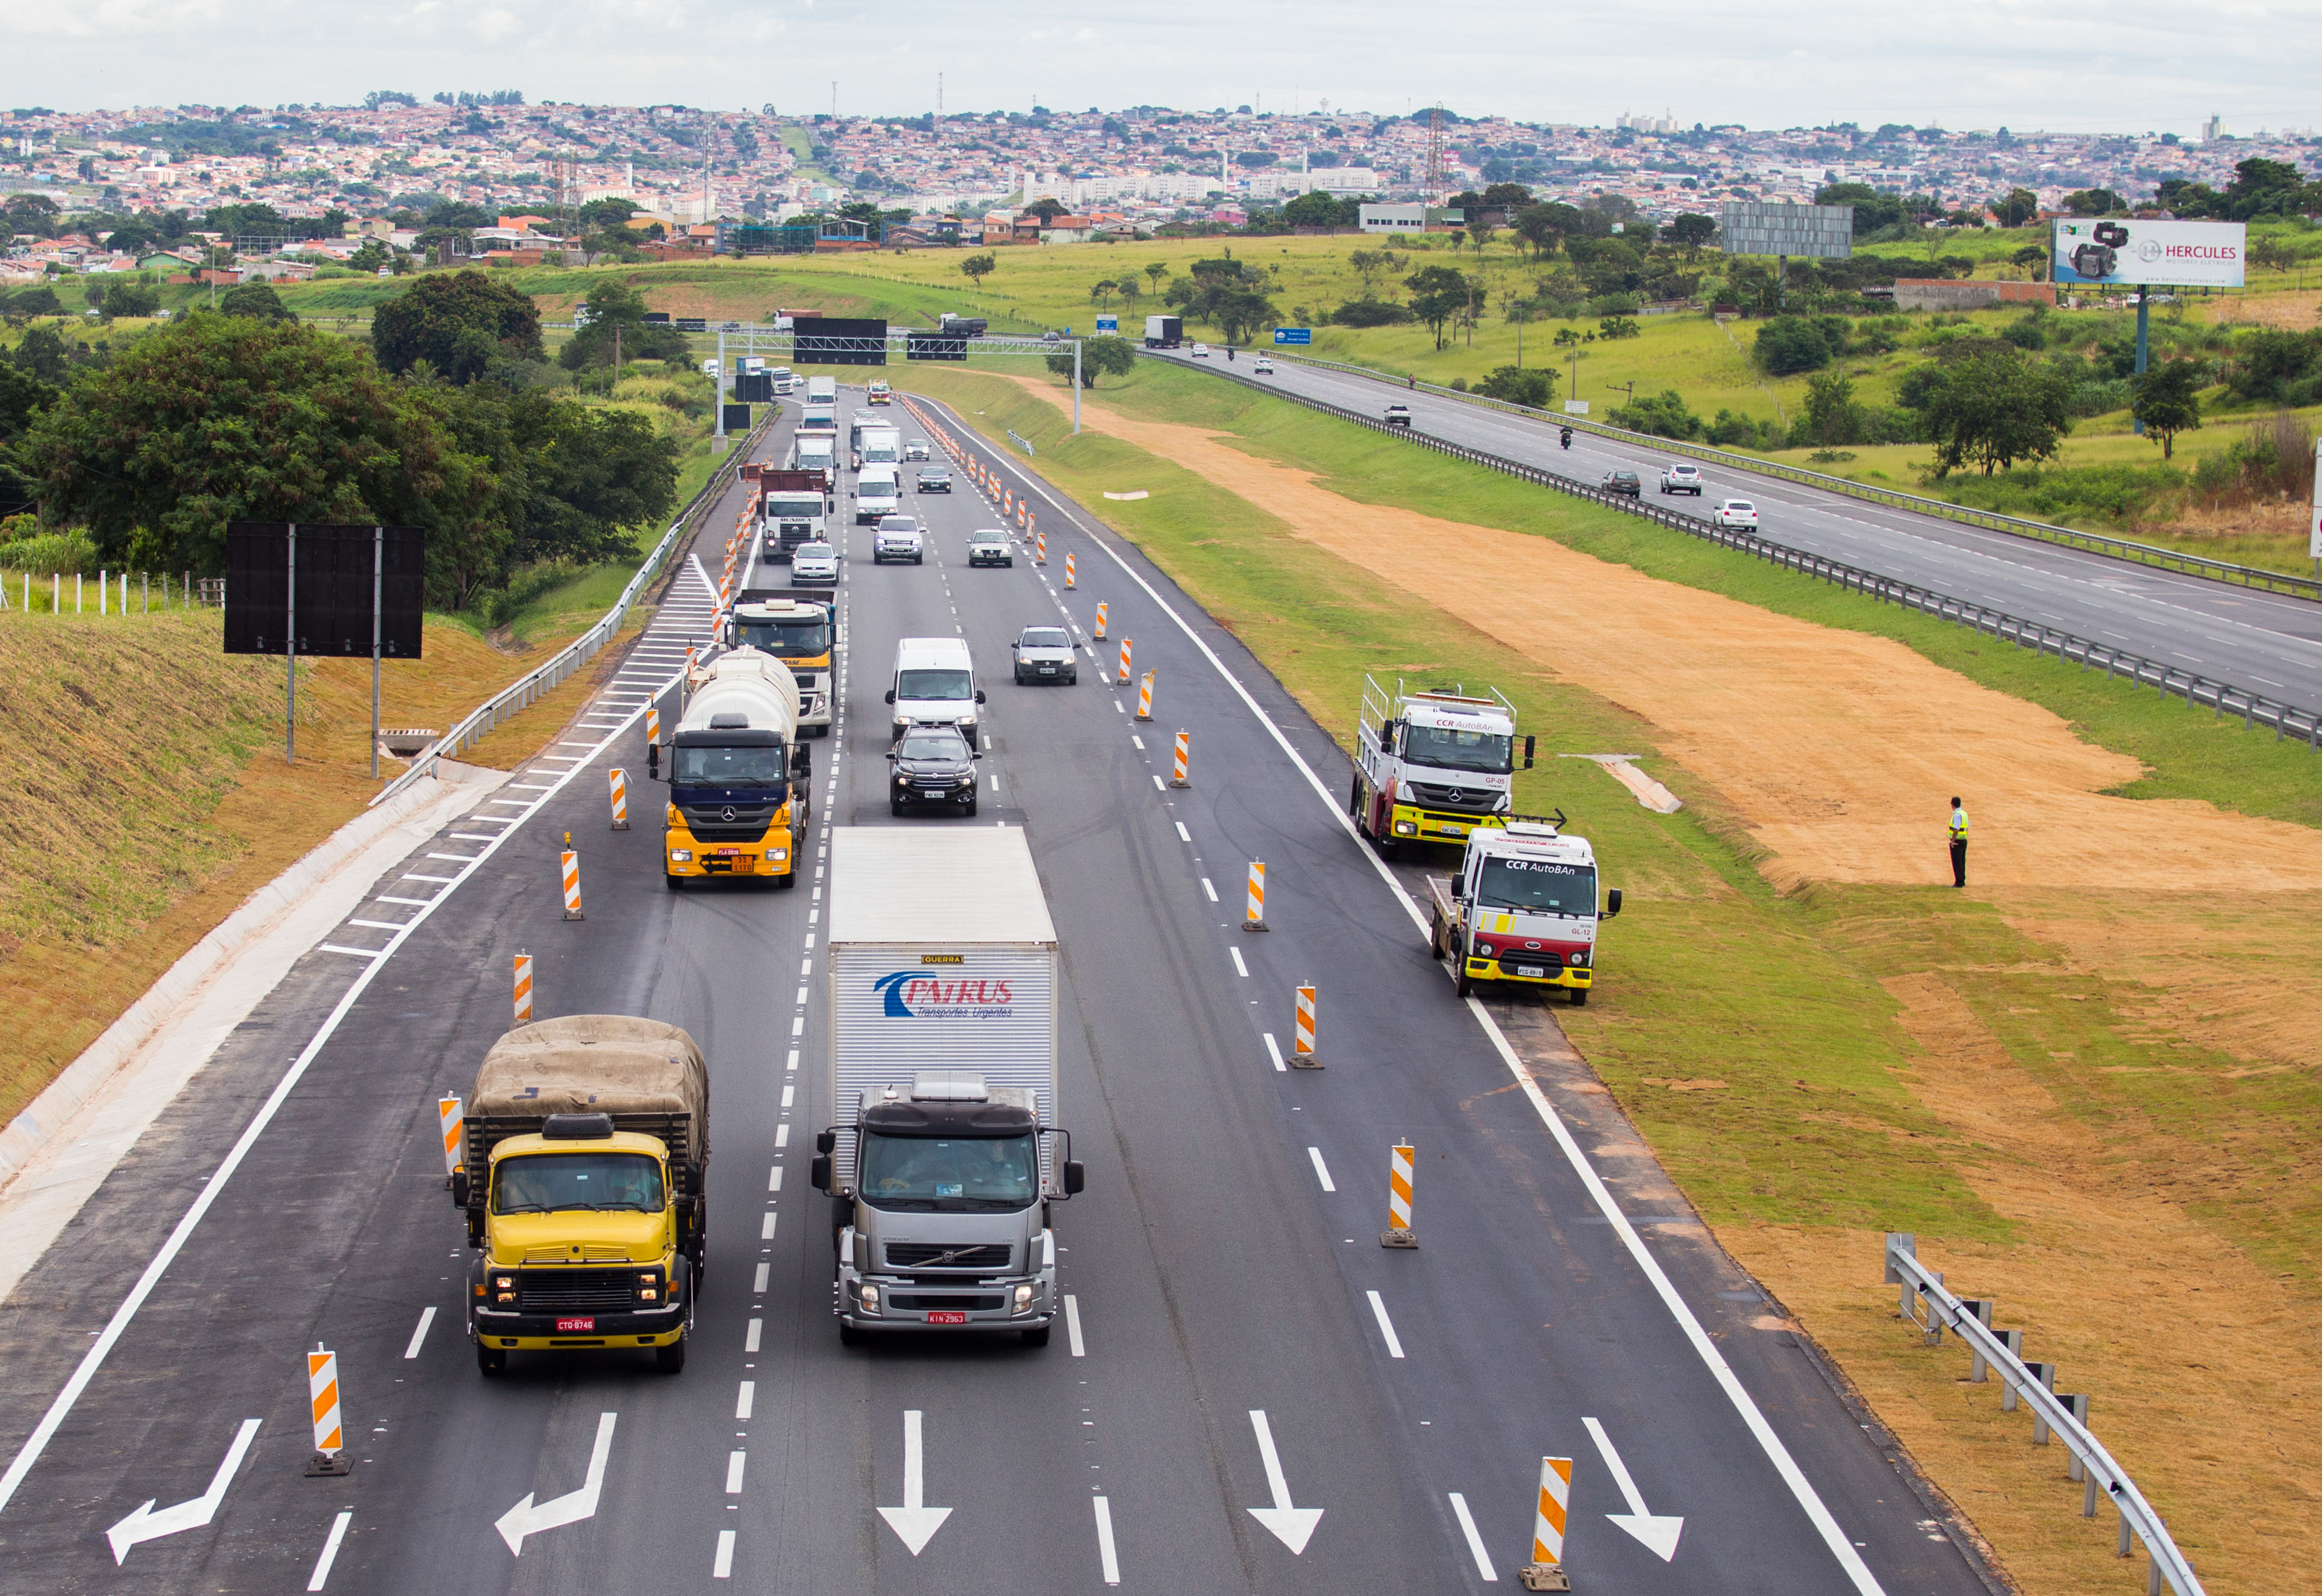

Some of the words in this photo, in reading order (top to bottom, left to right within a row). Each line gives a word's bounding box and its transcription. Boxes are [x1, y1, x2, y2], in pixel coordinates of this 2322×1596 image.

[2166, 245, 2236, 259] HERCULES
[1456, 721, 1493, 732] AutoBAn
[1505, 860, 1528, 871] CCR
[1529, 863, 1575, 876] AutoBAn
[906, 980, 1014, 1004] PATRUS
[917, 1007, 969, 1019] Transportes
[972, 1007, 1012, 1019] Urgentes
